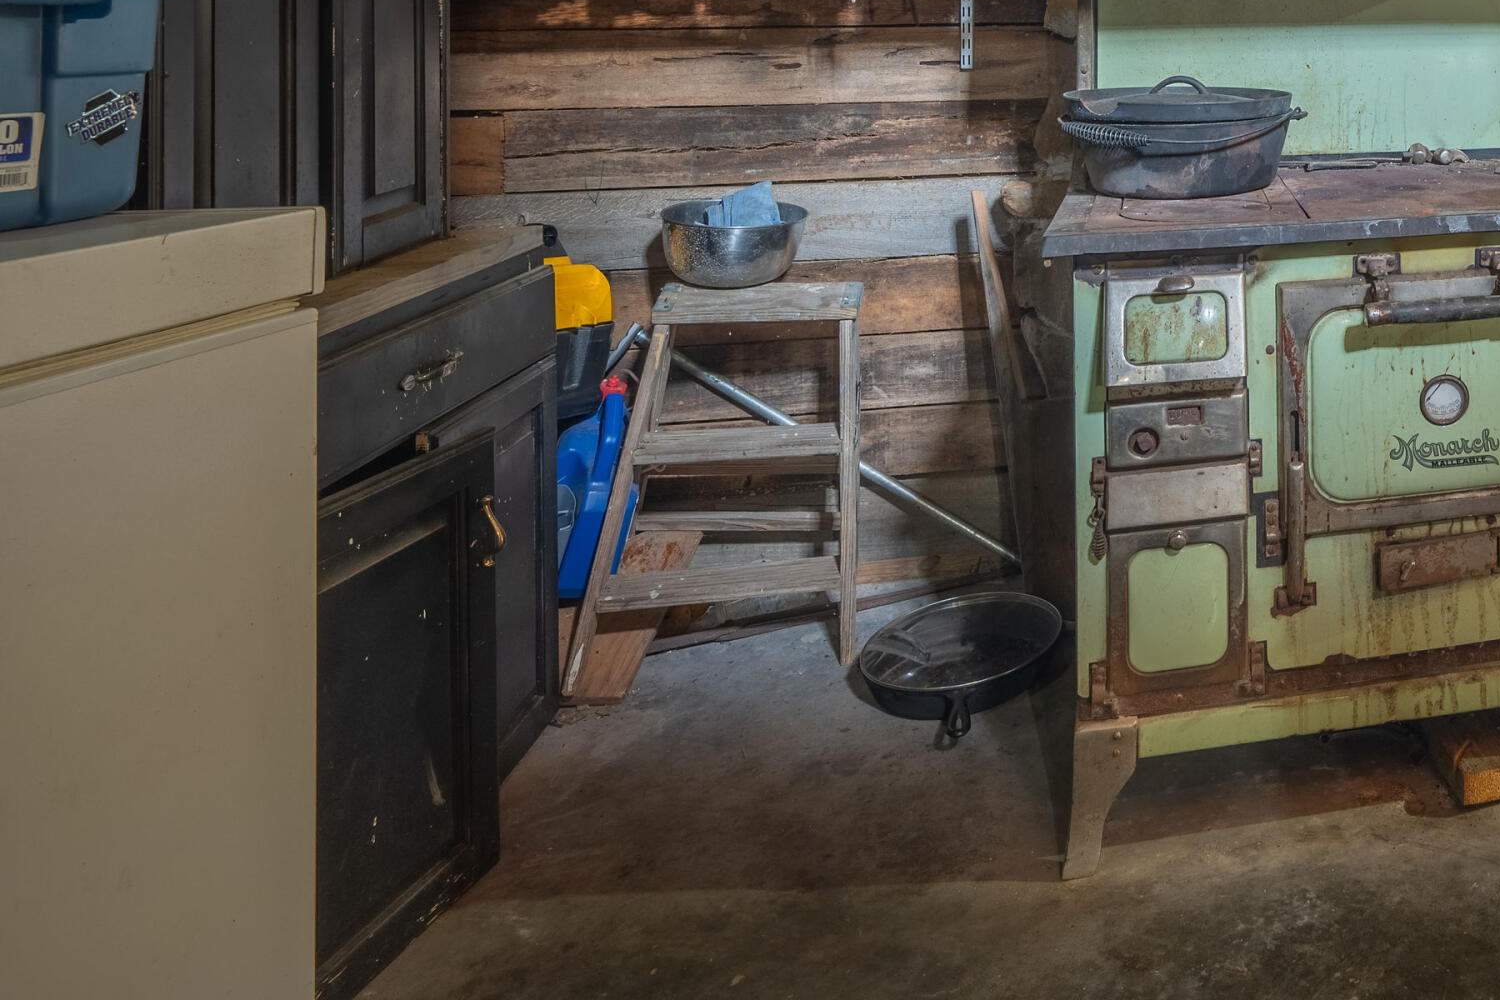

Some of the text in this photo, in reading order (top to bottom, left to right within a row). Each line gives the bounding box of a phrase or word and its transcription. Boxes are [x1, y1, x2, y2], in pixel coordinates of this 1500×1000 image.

[81, 107, 136, 141] DURABLE
[1389, 428, 1500, 472] Monarch
[1431, 455, 1489, 469] MALLEABLE
